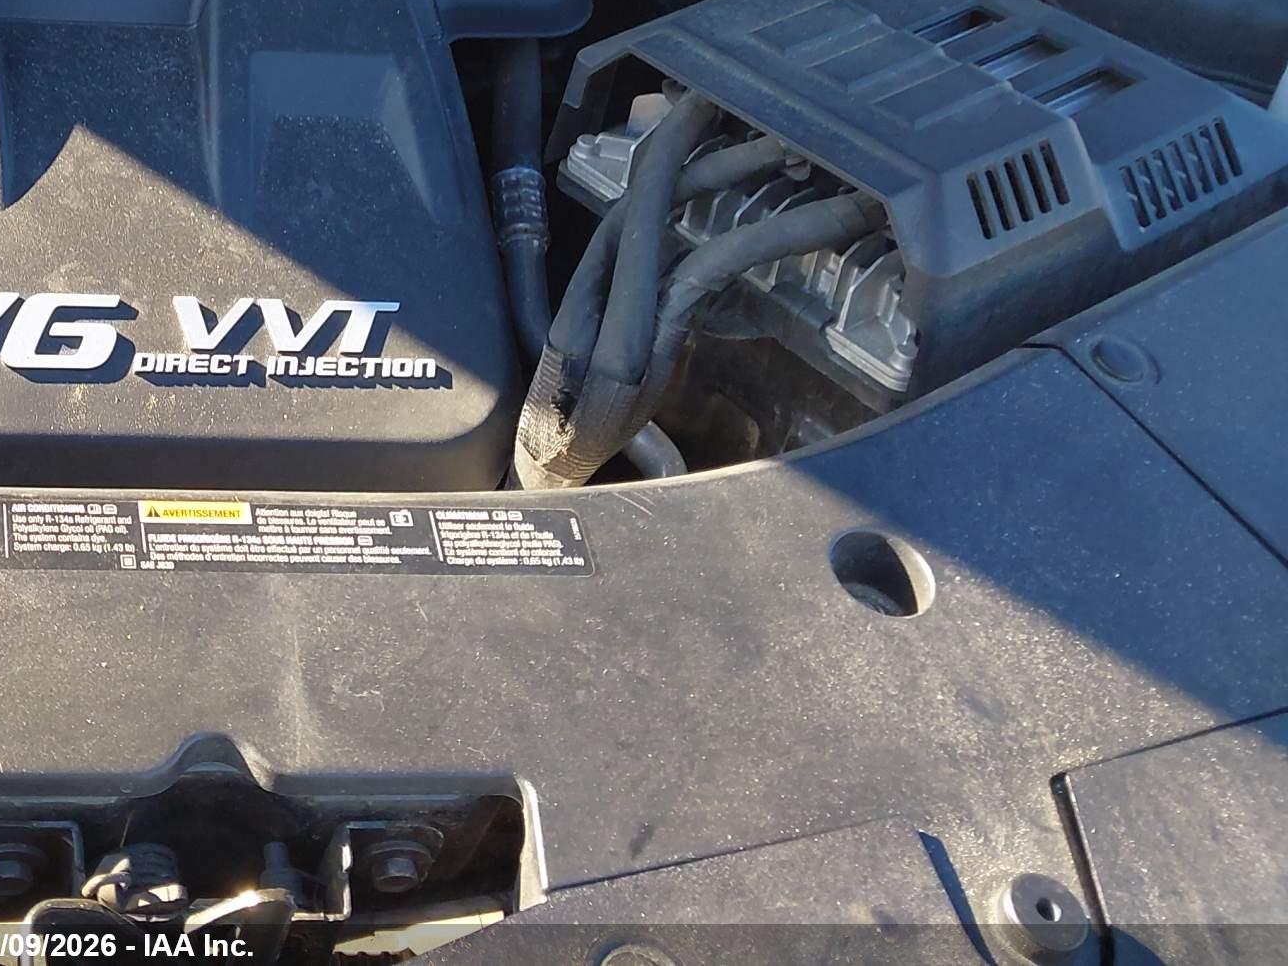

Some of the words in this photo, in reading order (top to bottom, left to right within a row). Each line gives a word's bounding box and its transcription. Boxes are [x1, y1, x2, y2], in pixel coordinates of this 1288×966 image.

[172, 296, 400, 354] VVT
[134, 352, 254, 375] DIRECT
[266, 355, 437, 378] INJECTION
[12, 504, 26, 512] AIR
[162, 510, 240, 518] AVERTISSEMENT
[12, 515, 26, 523] Use
[28, 515, 44, 524] only
[75, 516, 116, 525] Refrigerant
[118, 516, 132, 524] and
[60, 525, 83, 533] Glycol
[85, 525, 94, 533] oil
[29, 534, 56, 543] system
[58, 534, 89, 542] contains
[13, 542, 42, 552] System
[73, 543, 91, 551] 0.65
[92, 543, 102, 552] kg
